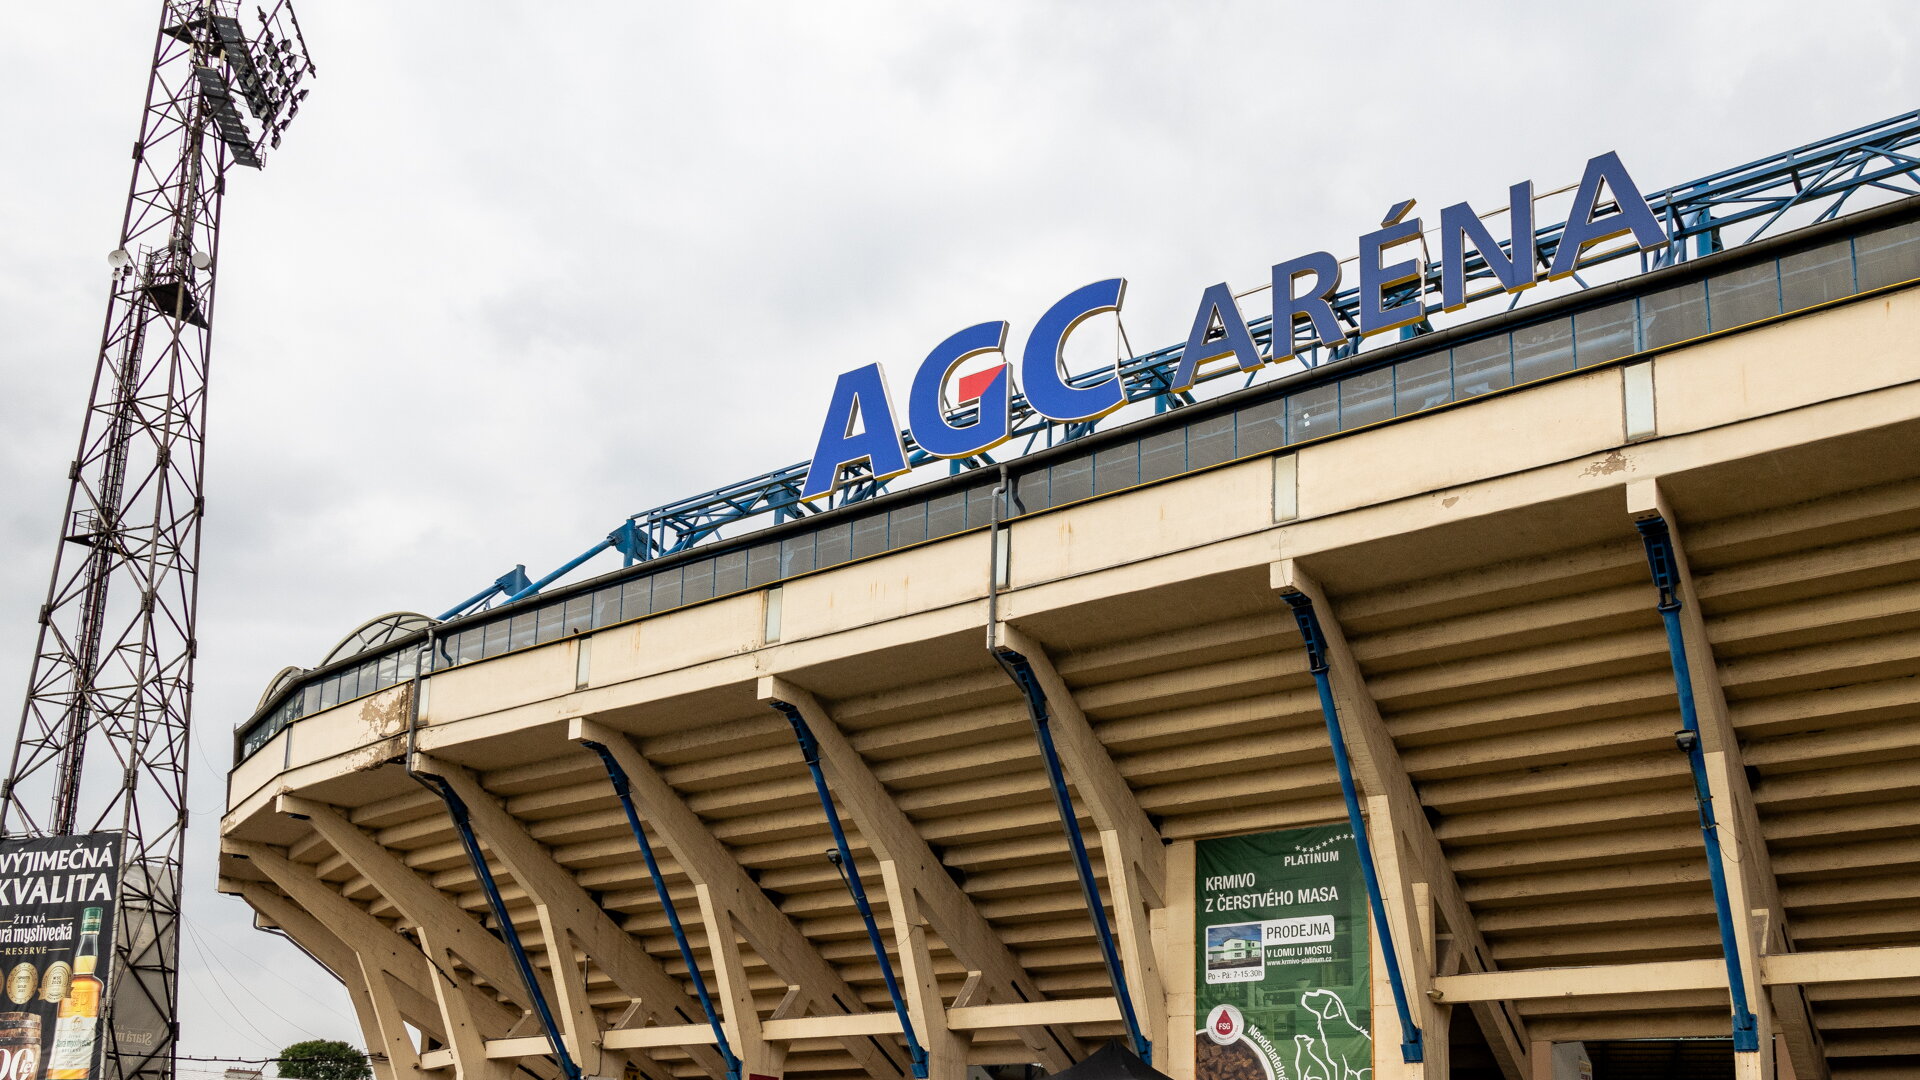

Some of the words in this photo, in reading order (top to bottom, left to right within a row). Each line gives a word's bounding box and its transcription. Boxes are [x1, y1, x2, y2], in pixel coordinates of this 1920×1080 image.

[801, 277, 1128, 502] AGC
[1170, 150, 1669, 393] ARÉNA
[0, 841, 113, 876] VÝJIMEČNÁ
[1284, 851, 1339, 866] PLATINUM
[1205, 872, 1255, 891] KRMIVO
[1205, 898, 1213, 912] Z
[1217, 889, 1293, 911] ČERSTVÉHO
[1298, 886, 1338, 903] MASA
[13, 913, 46, 924] ŽITNÁ
[13, 922, 73, 943] myslivecká
[1266, 922, 1331, 940] PRODEJNA
[5, 946, 47, 955] RESERVE
[1266, 949, 1272, 958] V
[1273, 948, 1295, 957] LOMU
[1297, 947, 1303, 956] U
[1304, 945, 1332, 955] MOSTU
[1266, 956, 1332, 966] www.krmivo-platinum.cz
[1218, 1022, 1231, 1030] FSG
